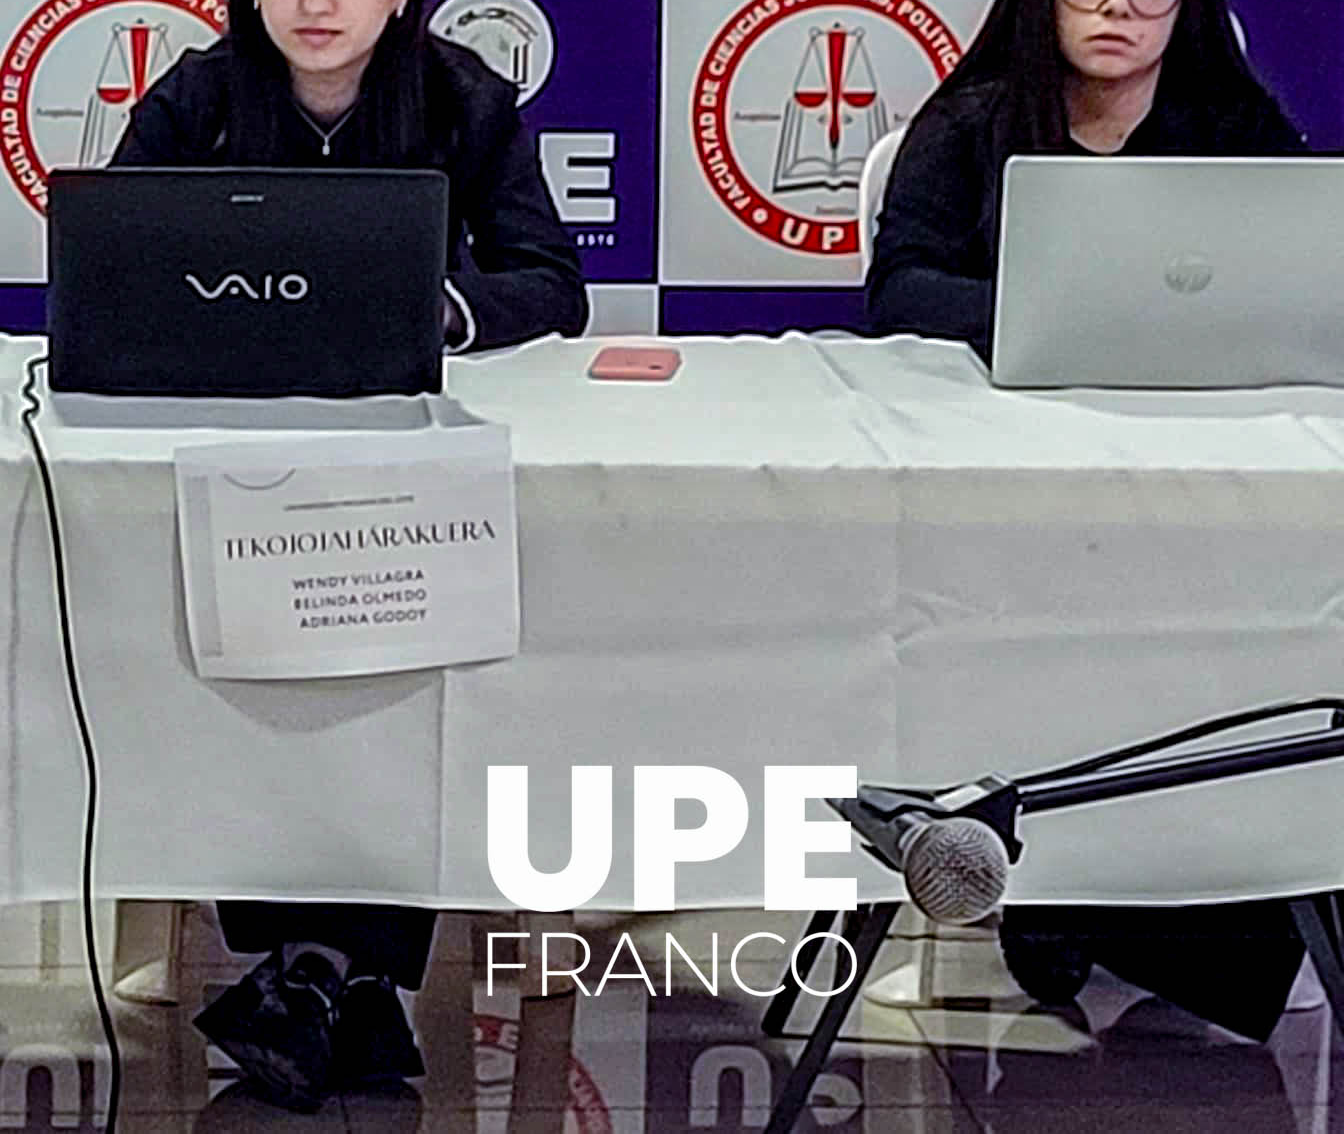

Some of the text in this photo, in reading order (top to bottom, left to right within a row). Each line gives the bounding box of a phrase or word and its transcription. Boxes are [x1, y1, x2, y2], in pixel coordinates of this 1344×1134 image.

[186, 274, 308, 299] VAIO
[293, 569, 424, 589] WENDY VILLAGRA
[294, 588, 426, 610] BELINDA OLMEDO
[300, 609, 426, 628] ADRIANA GODOY
